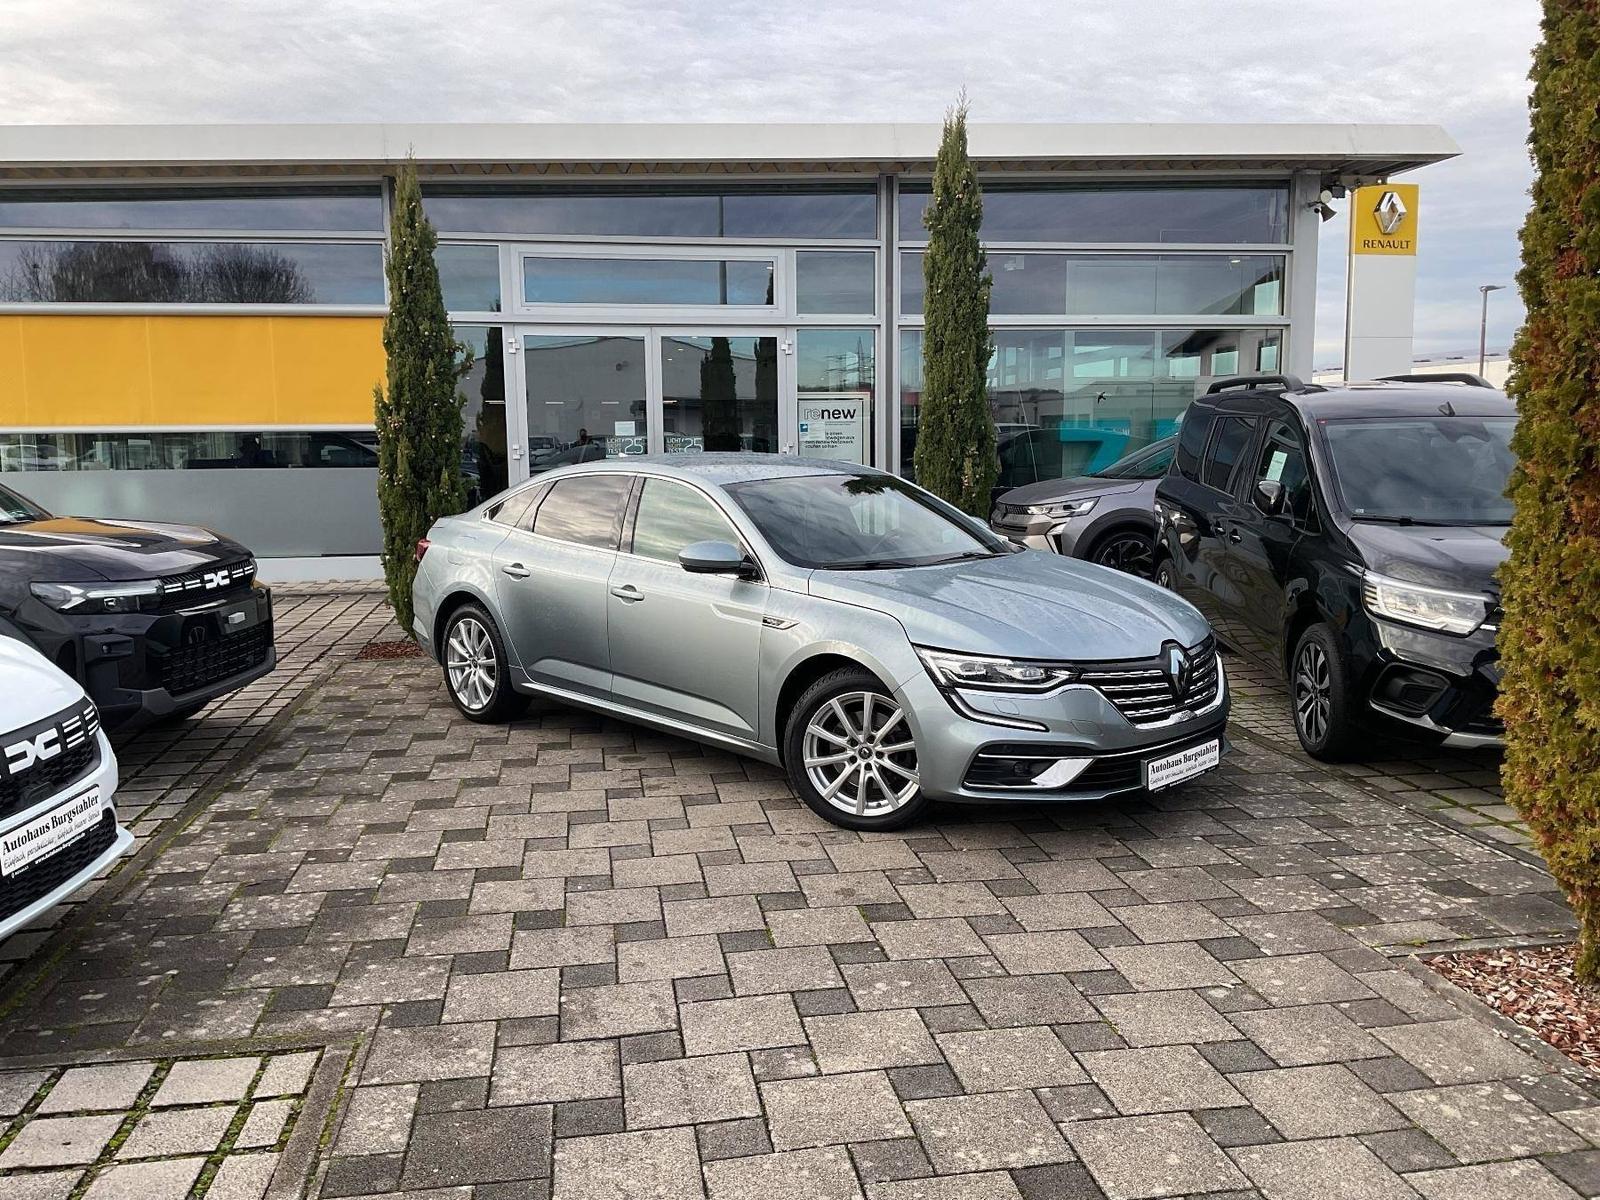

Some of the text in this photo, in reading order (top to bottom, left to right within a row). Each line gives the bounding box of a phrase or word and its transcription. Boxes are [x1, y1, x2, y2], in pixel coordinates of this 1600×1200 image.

[1363, 239, 1412, 249] RENAULT
[804, 408, 857, 420] renew
[1150, 757, 1183, 775] Autohaus
[1183, 744, 1218, 764] Burgstahler
[3, 821, 51, 855] Autohaus
[50, 794, 99, 829] Burgstahler
